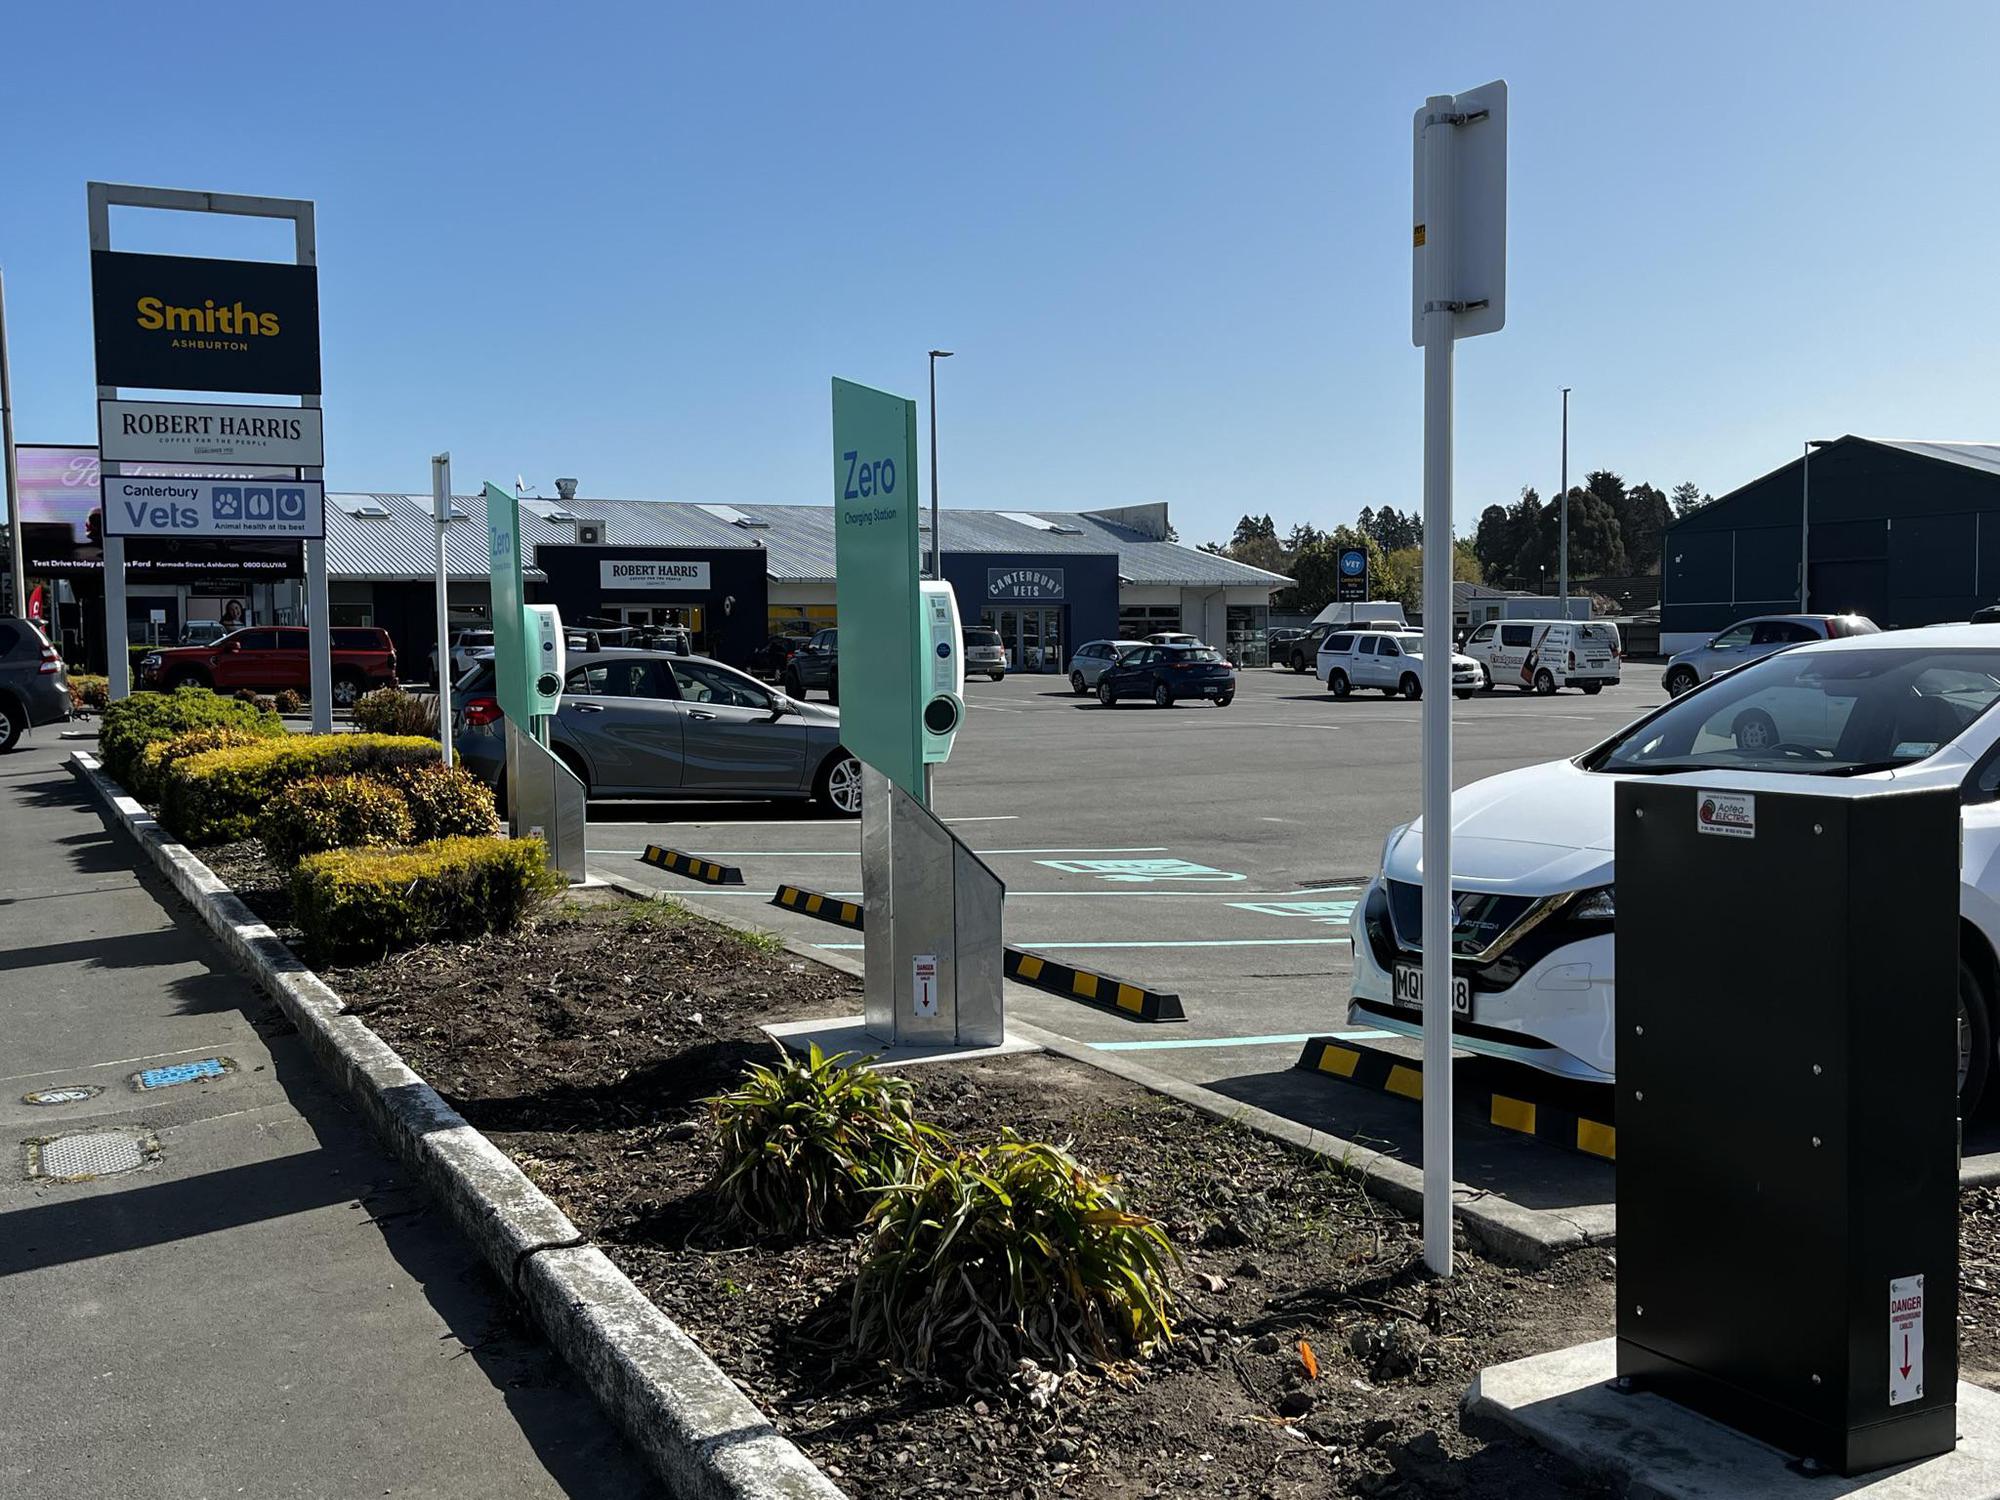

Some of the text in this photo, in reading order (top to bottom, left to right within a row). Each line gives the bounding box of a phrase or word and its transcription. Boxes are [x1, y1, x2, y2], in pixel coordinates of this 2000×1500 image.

[137, 297, 280, 336] Smiths
[172, 339, 248, 351] ASHBURTON
[122, 413, 301, 440] ROBERT HARRIS
[843, 450, 896, 499] Zero
[123, 484, 199, 500] Canterbury
[124, 501, 199, 529] Vets
[845, 507, 897, 526] Charging Station
[214, 522, 241, 530] Animal
[278, 523, 287, 531] its
[491, 526, 511, 556] Zero
[51, 560, 72, 568] Drive
[73, 559, 95, 569] today
[132, 560, 151, 568] Ford
[613, 564, 698, 578] ROBERT HARRIS
[1344, 559, 1361, 569] VET
[990, 571, 1062, 595] CANTERBURY
[1013, 585, 1039, 596] VETS
[1717, 802, 1745, 814] Aotea
[1715, 813, 1750, 823] ELECTRIC
[1892, 1296, 1921, 1313] DANGER
